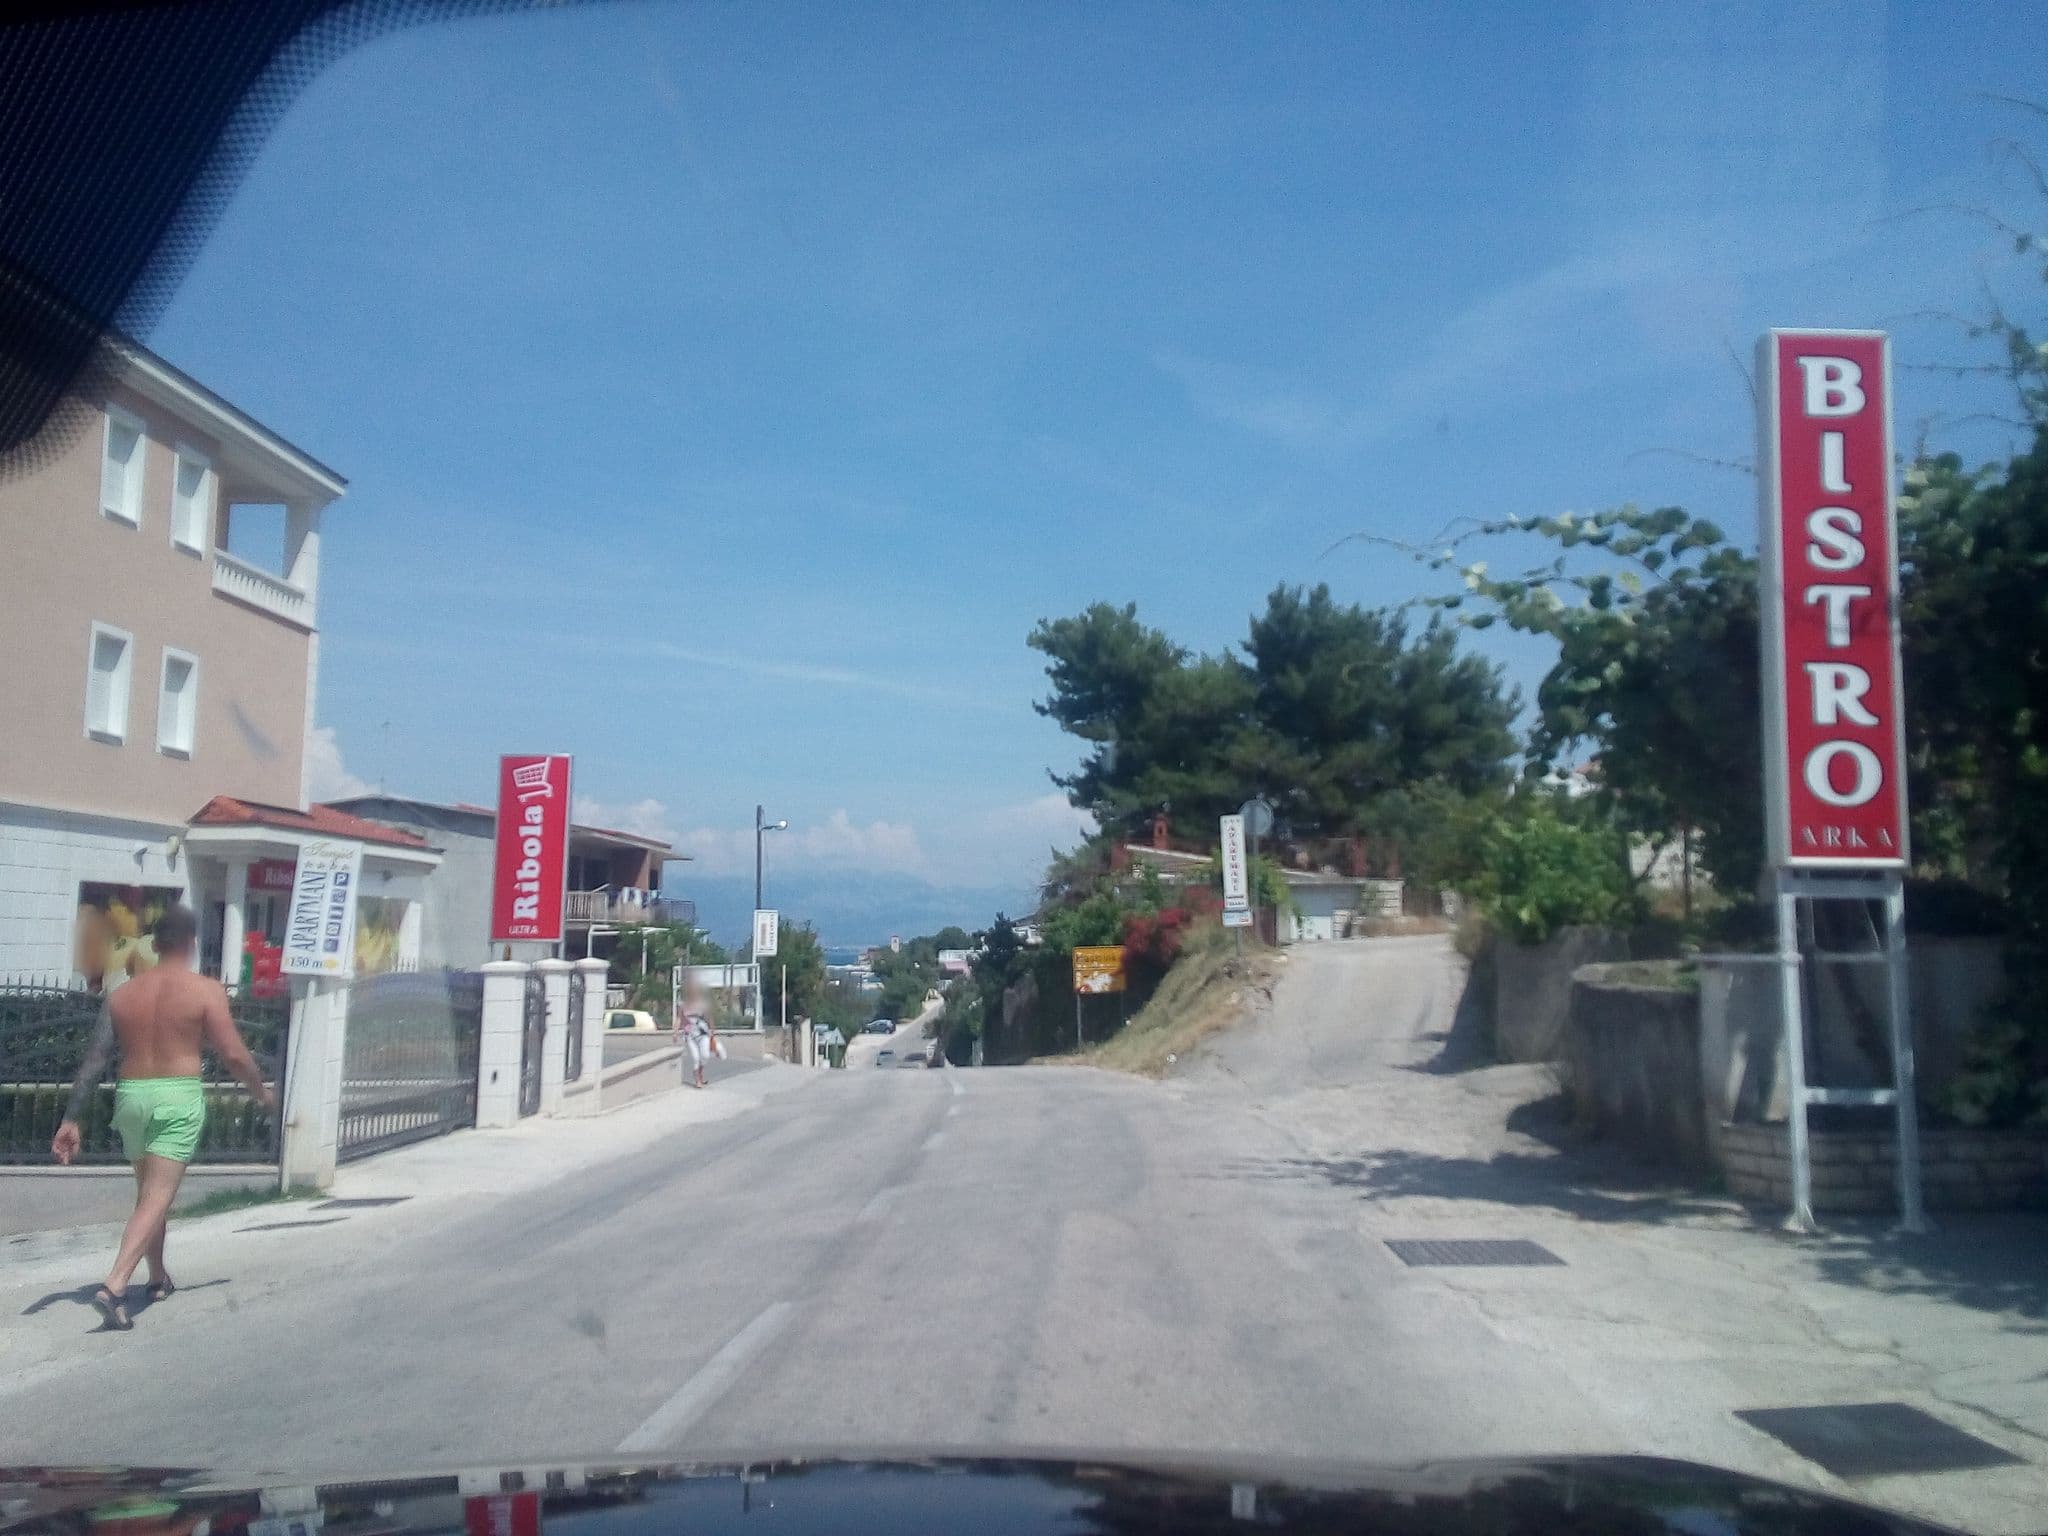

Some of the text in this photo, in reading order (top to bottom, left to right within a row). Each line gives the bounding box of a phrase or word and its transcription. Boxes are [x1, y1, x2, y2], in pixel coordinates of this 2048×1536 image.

[1797, 355, 1884, 808] BISTRO
[512, 804, 545, 920] Ribola
[1801, 825, 1894, 848] ARKA
[289, 956, 310, 968] 150
